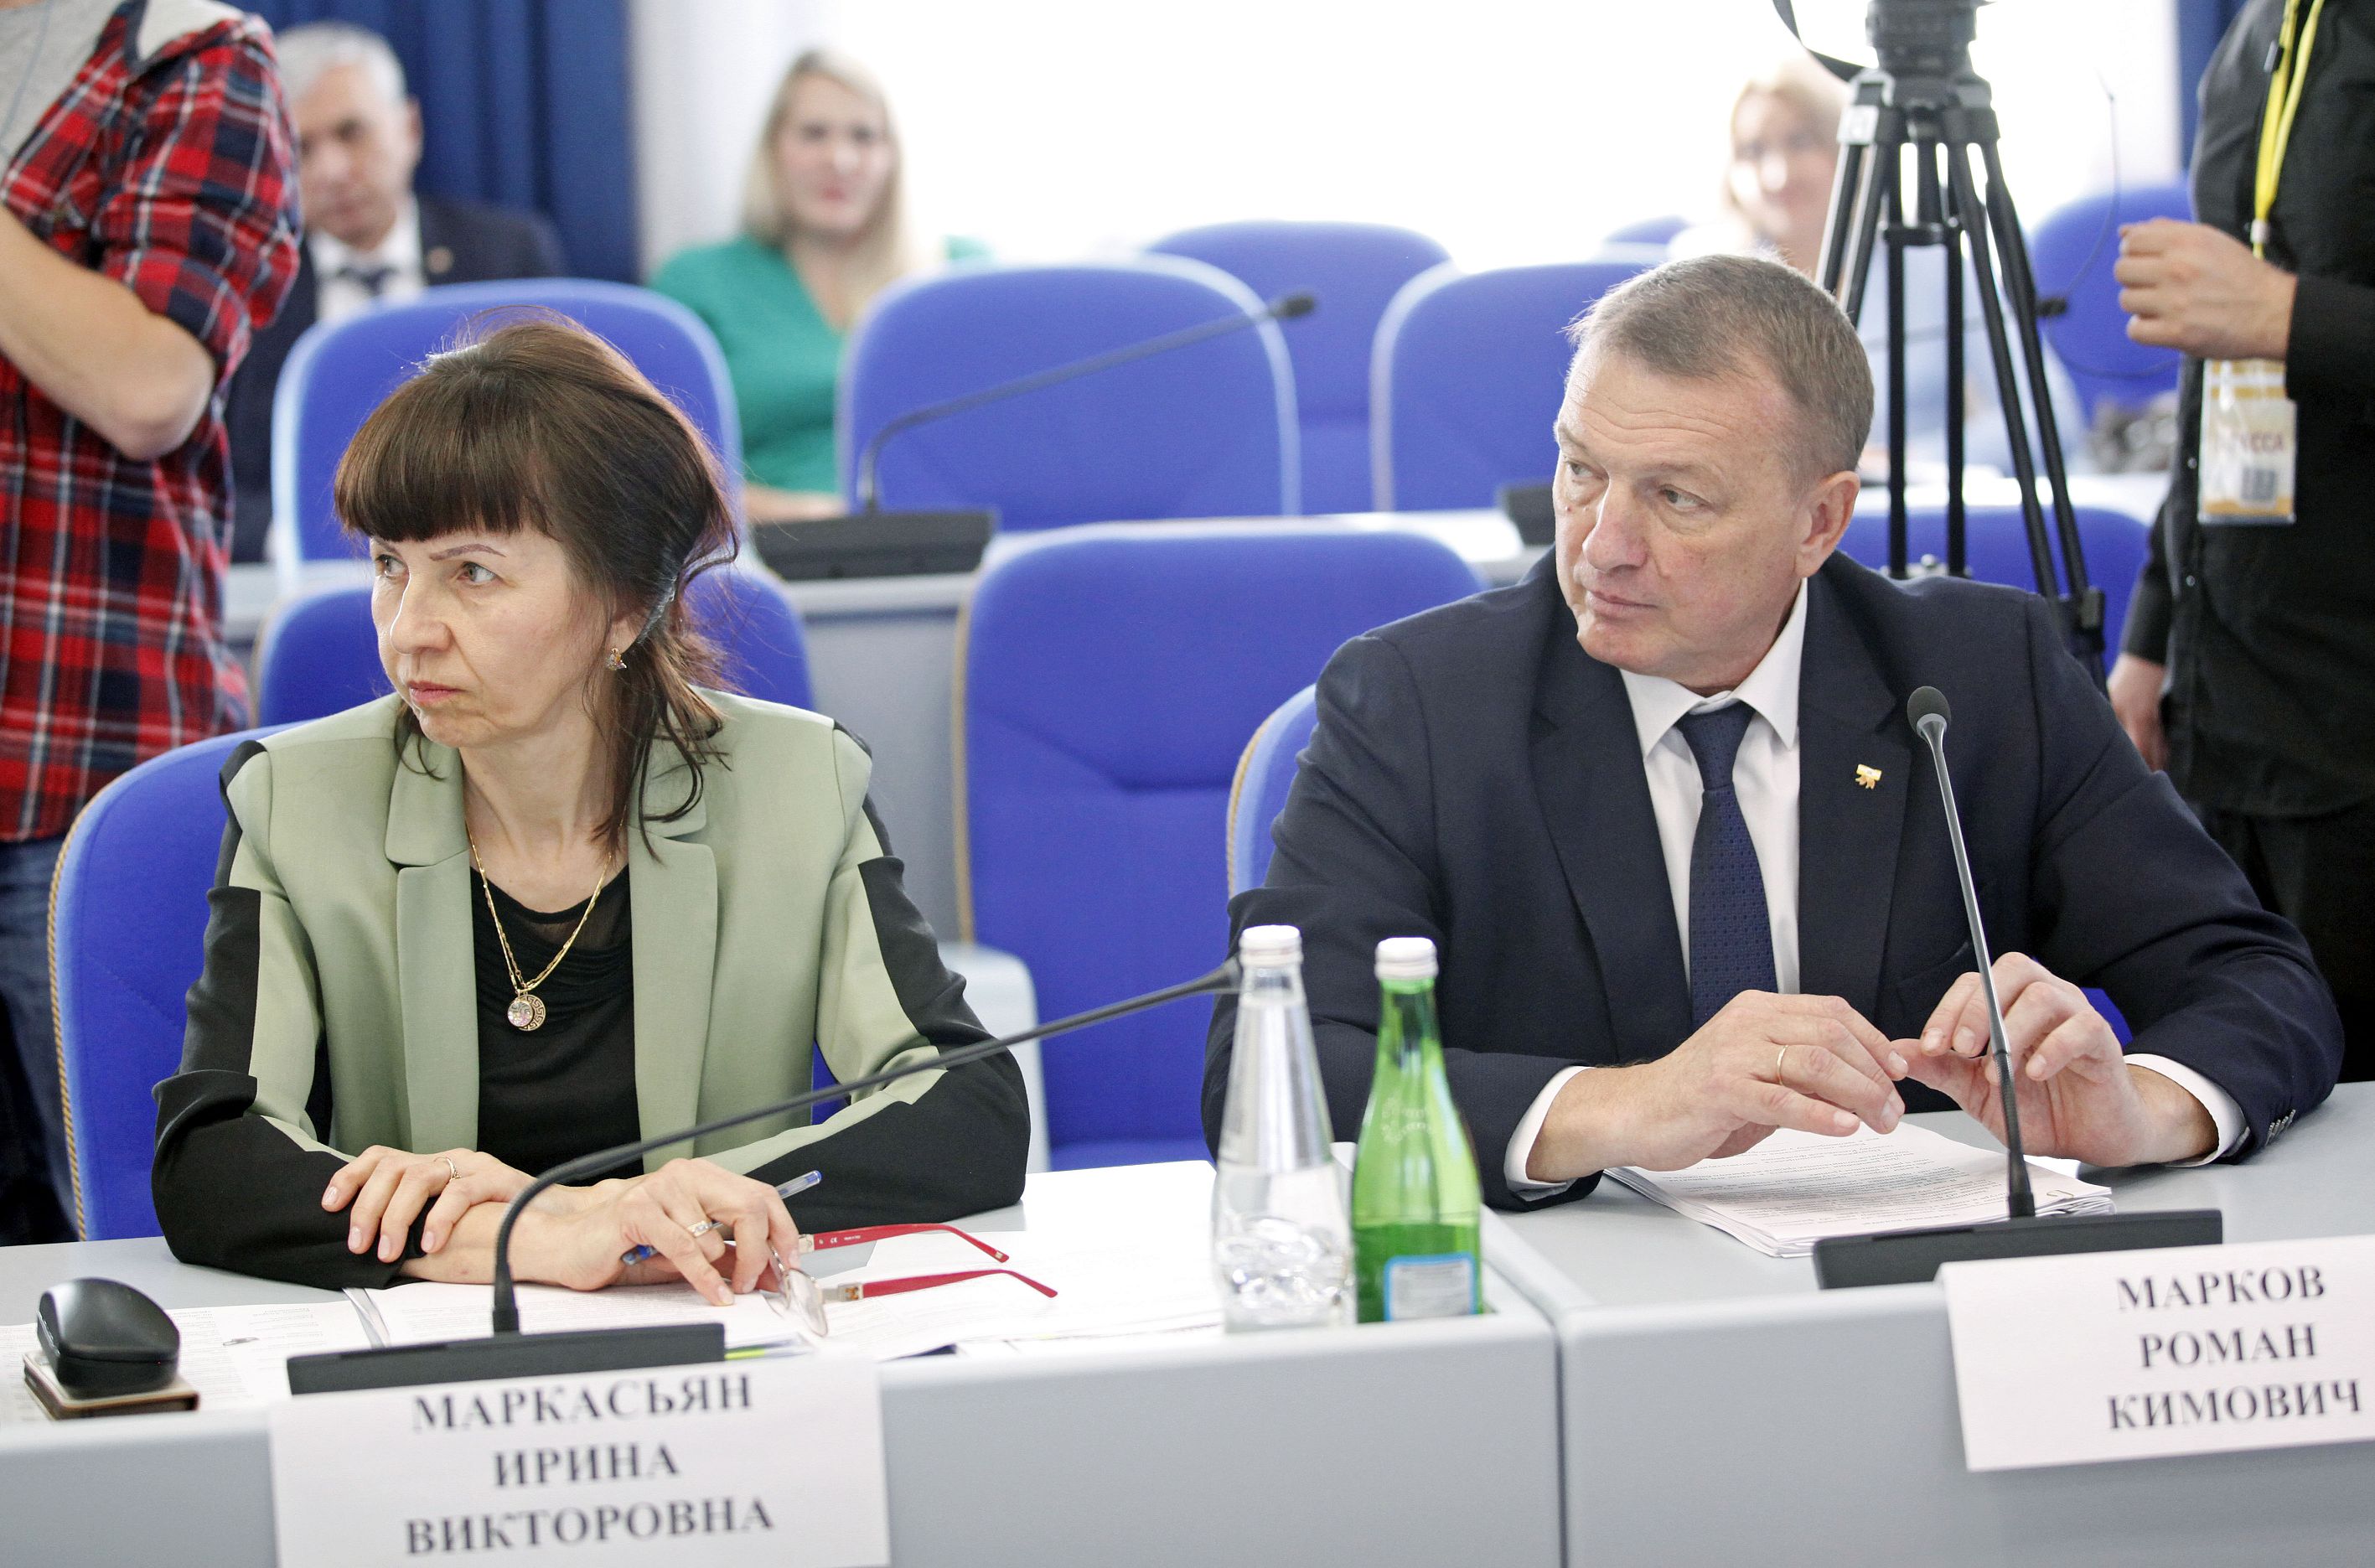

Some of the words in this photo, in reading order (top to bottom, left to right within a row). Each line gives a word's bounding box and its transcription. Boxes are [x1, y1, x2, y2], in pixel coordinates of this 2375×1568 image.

[2117, 1265, 2326, 1310] МАРКОВ
[2140, 1322, 2316, 1369] РОМАН
[413, 1373, 752, 1431] МАРКАСЬЯН
[2108, 1379, 2362, 1430] КИМОВИЧ
[494, 1441, 679, 1489] ИРИНА
[406, 1496, 774, 1556] ВИКТОРОВНА
